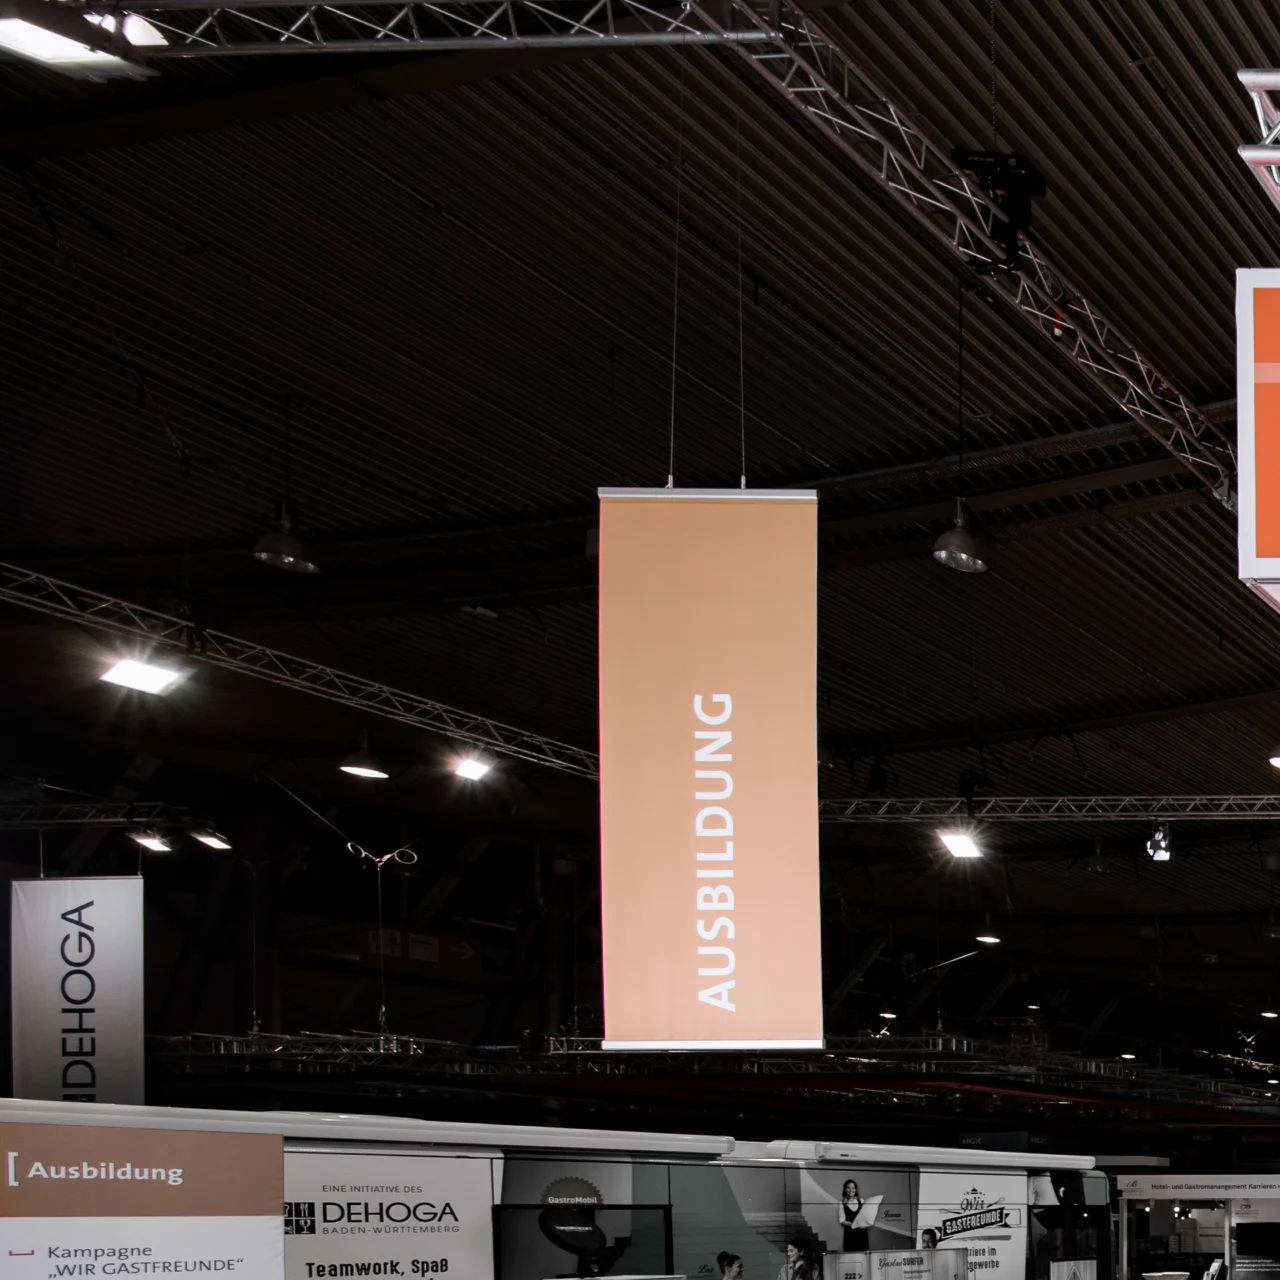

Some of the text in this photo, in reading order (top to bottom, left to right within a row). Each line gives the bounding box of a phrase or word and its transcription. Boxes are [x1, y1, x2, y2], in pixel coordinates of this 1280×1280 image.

[695, 692, 733, 1011] AUSBILDUNG
[60, 901, 96, 1089] DEHOGA
[27, 1161, 184, 1186] Ausbildung
[322, 1185, 423, 1194] EINE INITIATIVE DES
[548, 1196, 598, 1204] GastroMobil
[322, 1202, 459, 1224] DEHOGA
[945, 1209, 1001, 1234] GASTFREUNDE
[322, 1225, 461, 1235] BADEN-WÜRTTEMBERG
[47, 1246, 153, 1261] Kampagne
[102, 1257, 245, 1276] GASTFREUNDE“
[306, 1259, 405, 1279] Teamwork,
